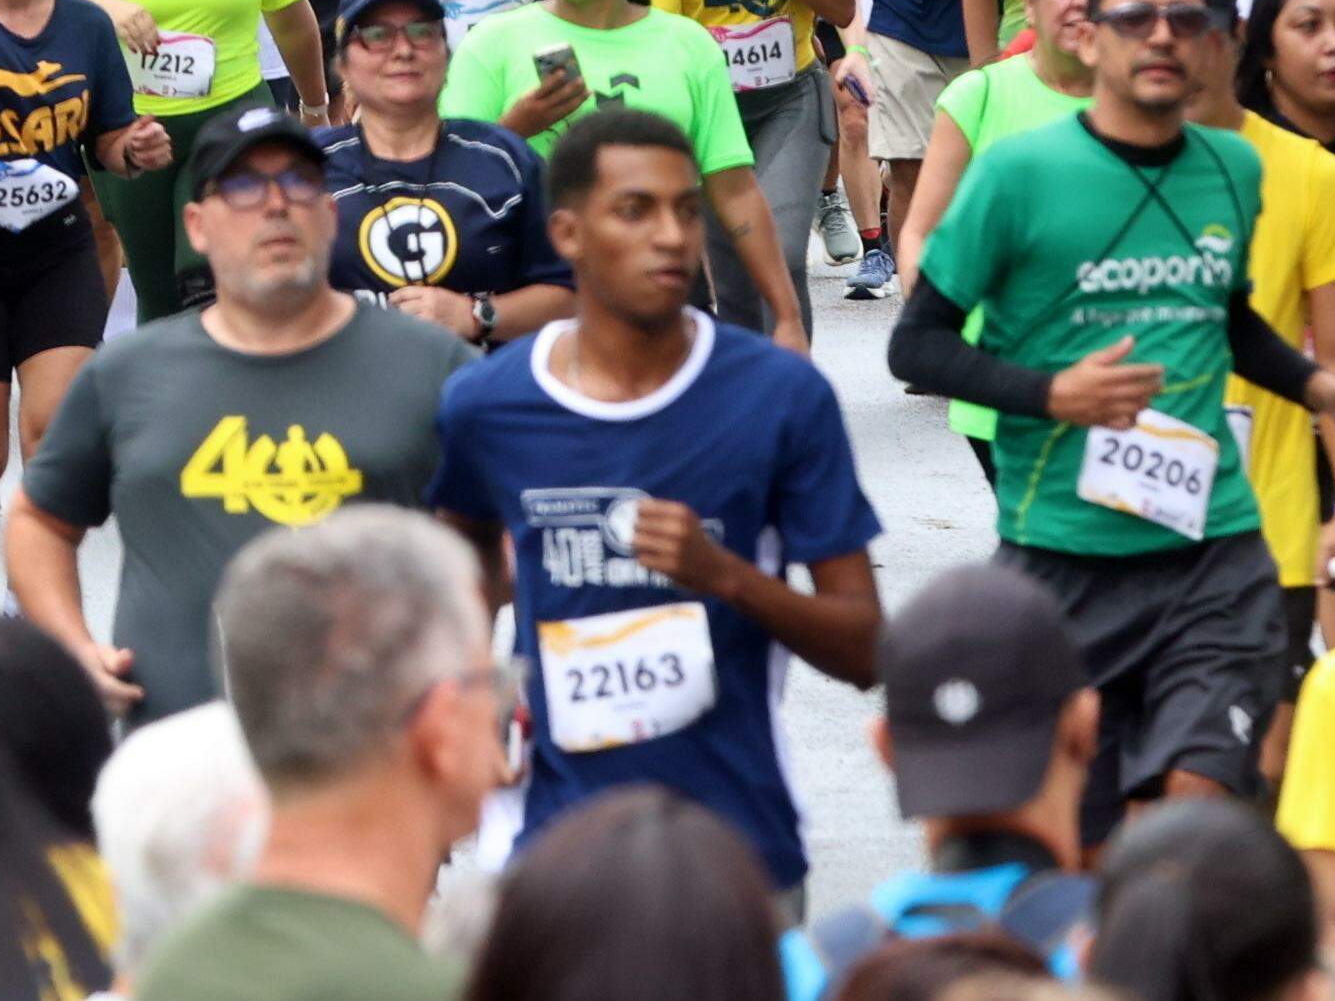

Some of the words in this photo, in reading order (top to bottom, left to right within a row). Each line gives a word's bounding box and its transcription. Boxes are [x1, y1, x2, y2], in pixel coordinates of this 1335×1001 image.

[141, 53, 196, 75] 17212
[723, 40, 783, 68] 14614
[369, 203, 444, 281] G
[1100, 436, 1203, 496] 20206
[565, 652, 686, 704] 22163
